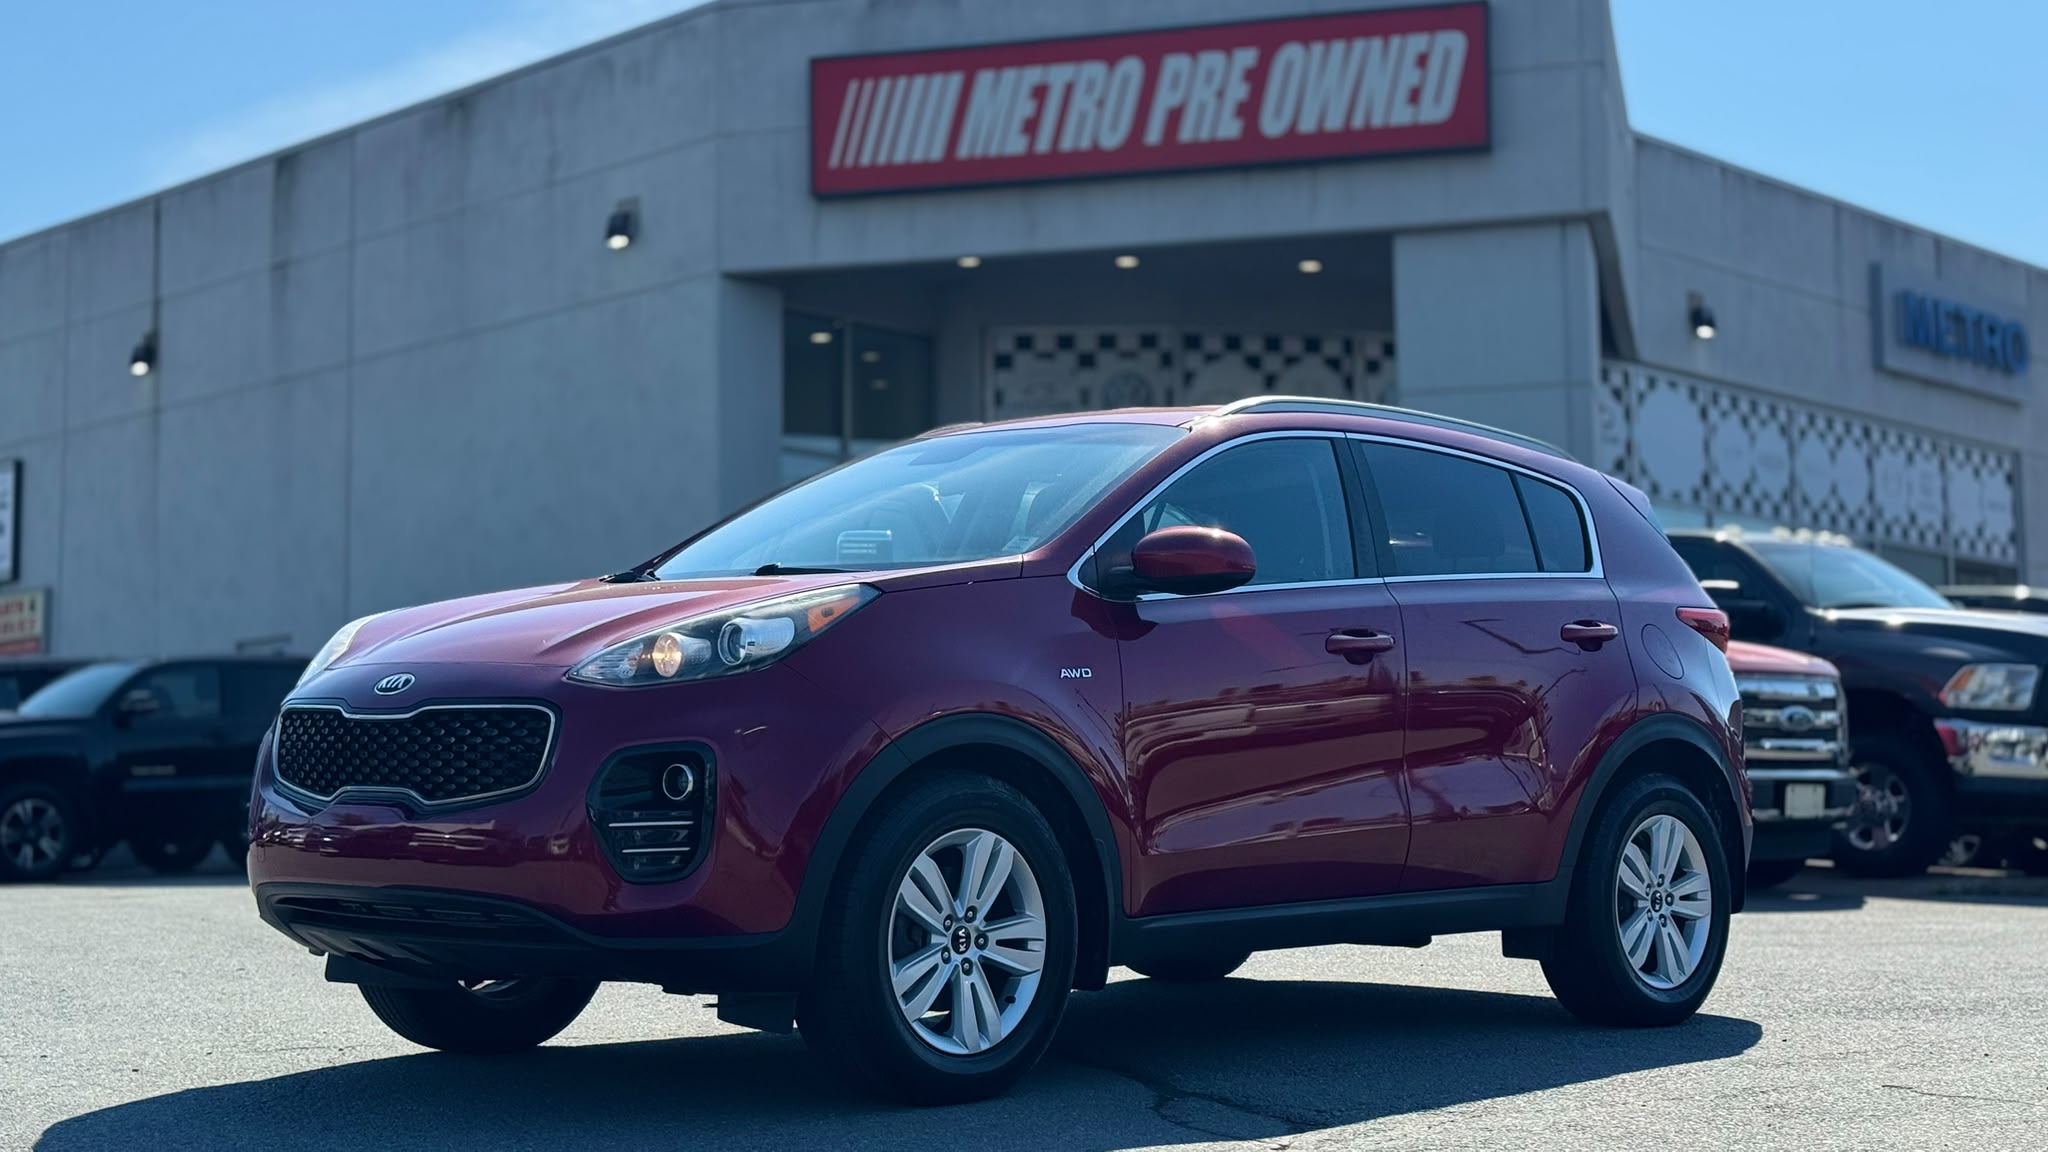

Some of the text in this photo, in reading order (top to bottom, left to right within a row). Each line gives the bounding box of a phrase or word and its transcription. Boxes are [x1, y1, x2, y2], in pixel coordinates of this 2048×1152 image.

[957, 31, 1468, 159] METRO PRE OWNED
[1899, 289, 2030, 374] METRO
[376, 674, 412, 690] KIA
[1060, 667, 1092, 679] AWD
